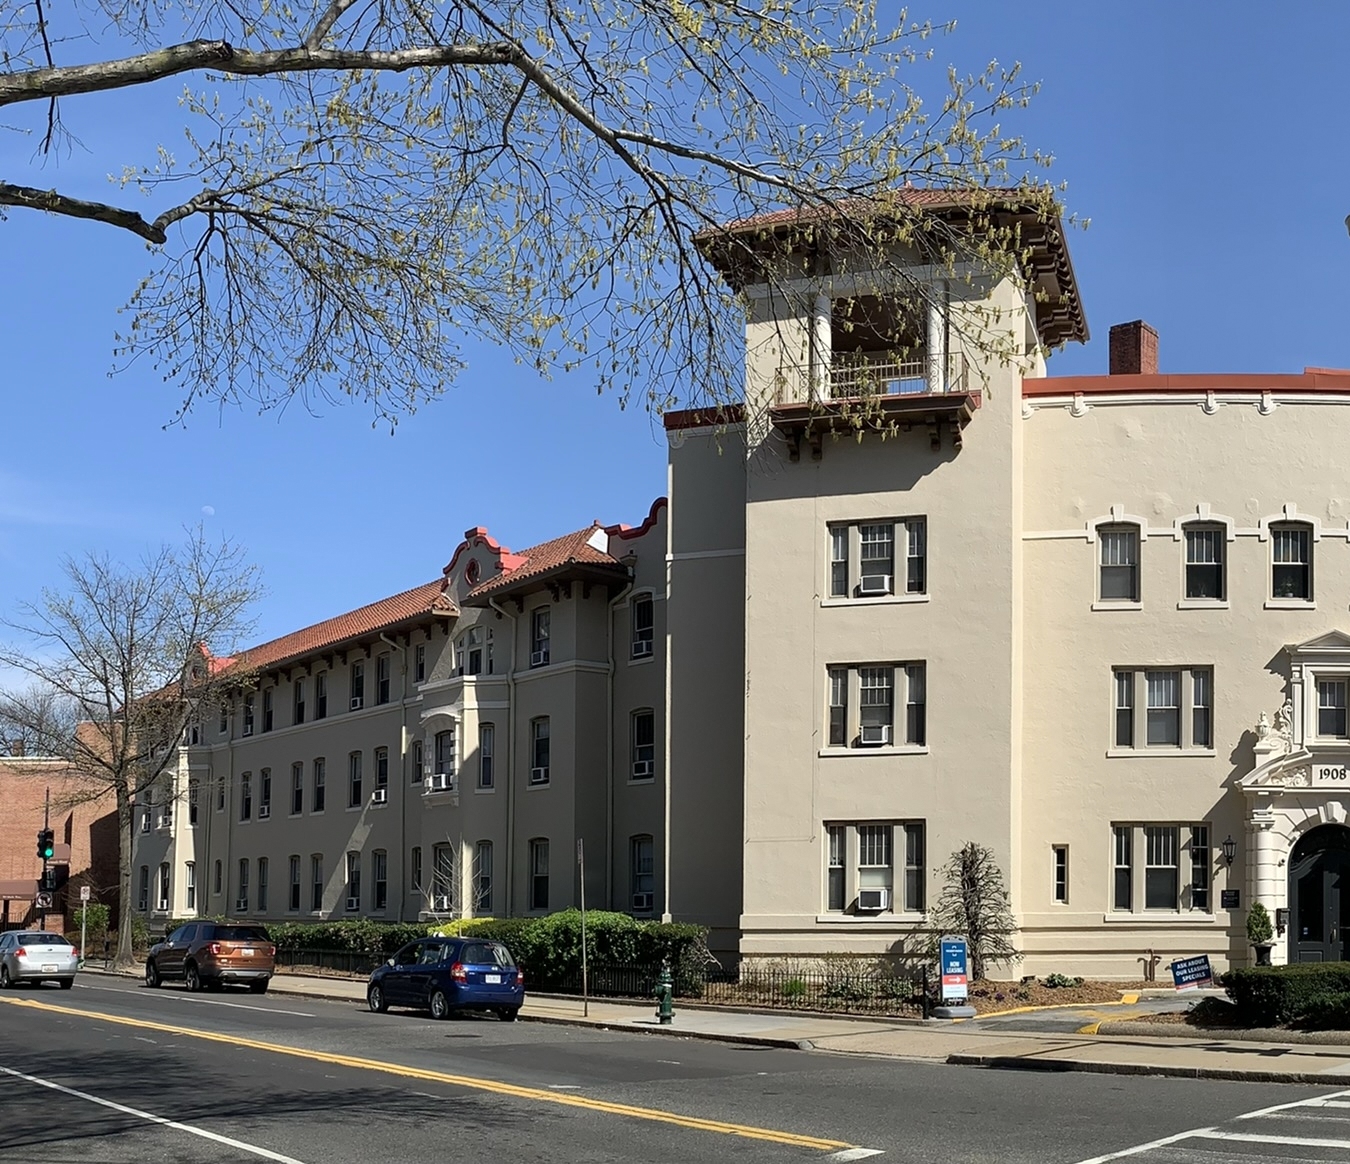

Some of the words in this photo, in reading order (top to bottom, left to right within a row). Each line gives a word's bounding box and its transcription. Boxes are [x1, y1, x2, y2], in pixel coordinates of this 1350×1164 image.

[1319, 768, 1347, 780] 1908
[1188, 958, 1204, 967] ABOUT
[1188, 964, 1208, 974] LEASING
[1182, 971, 1206, 981] SPECIALS
